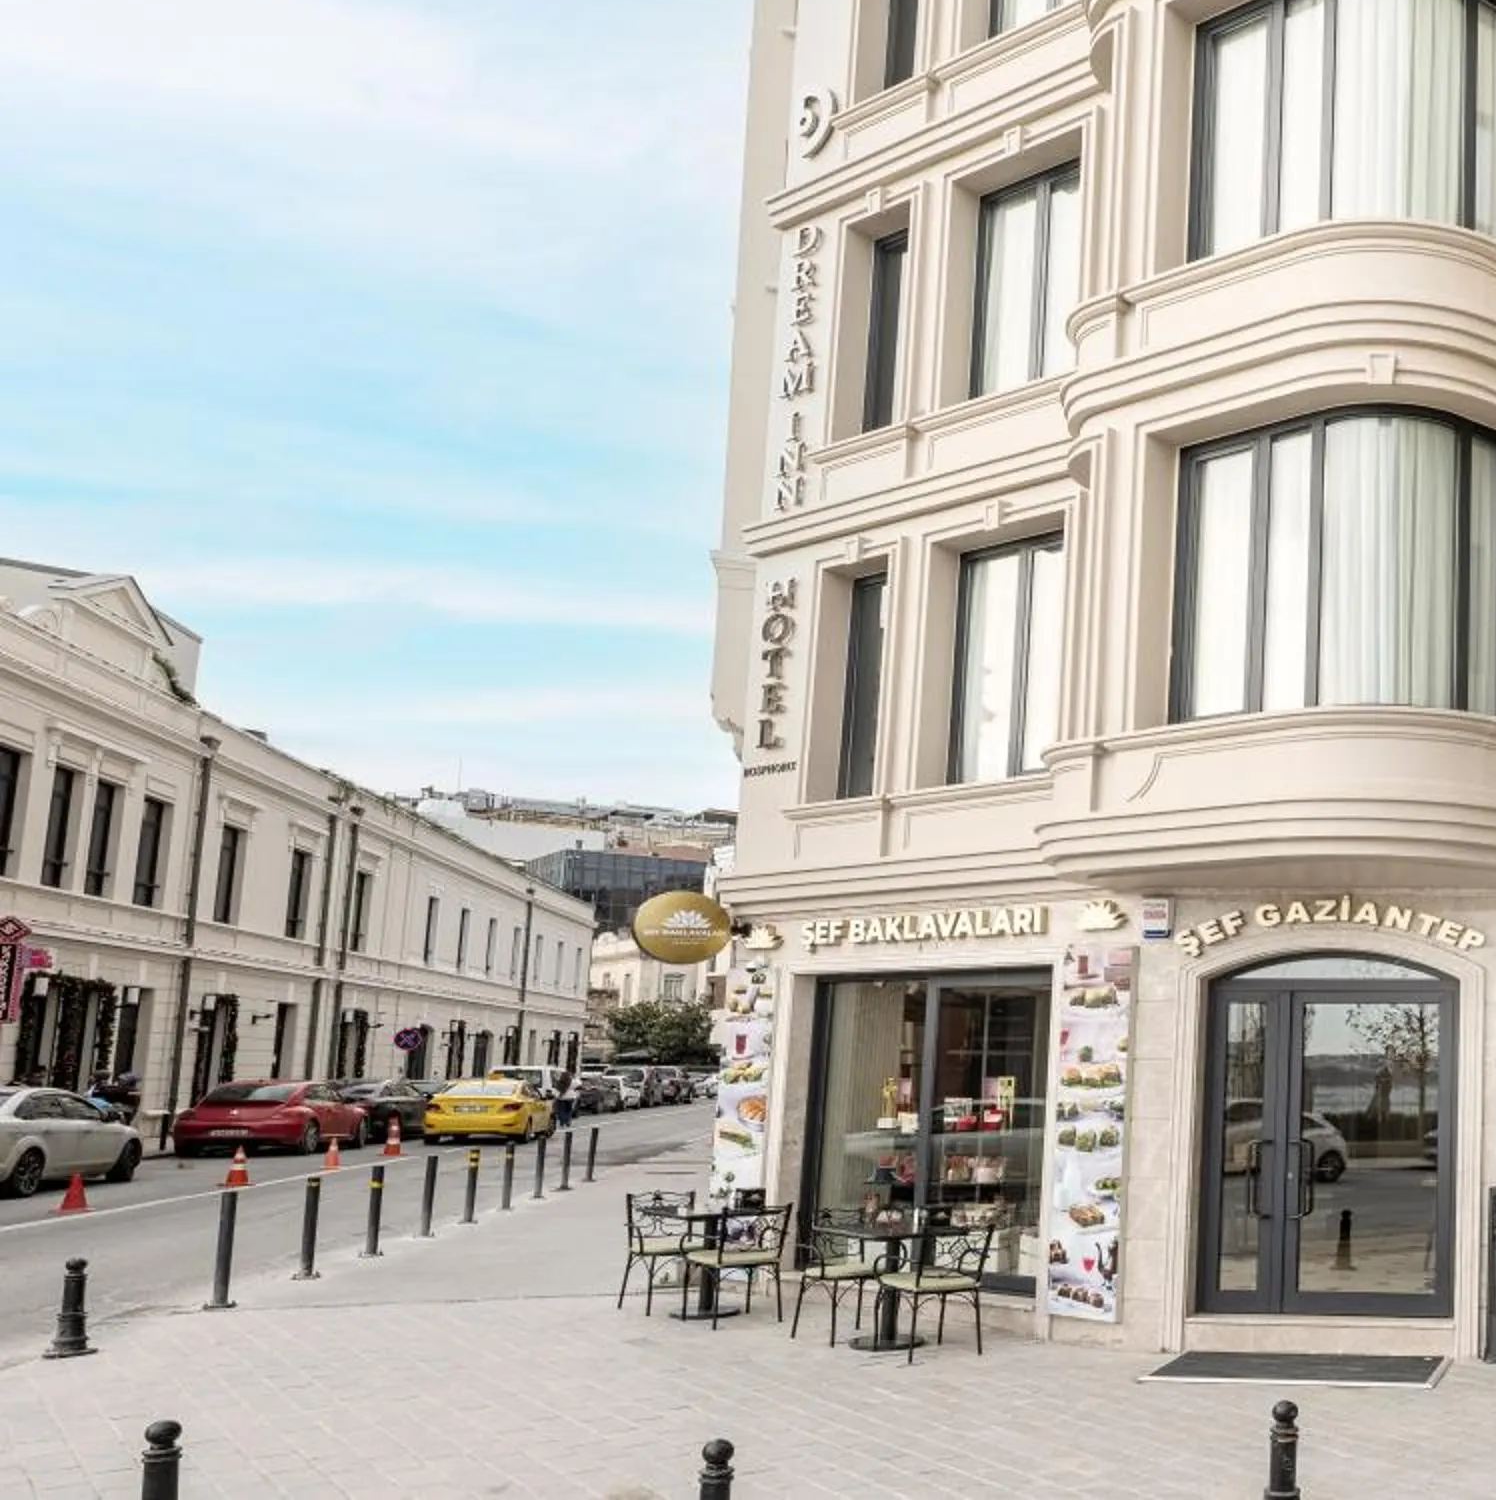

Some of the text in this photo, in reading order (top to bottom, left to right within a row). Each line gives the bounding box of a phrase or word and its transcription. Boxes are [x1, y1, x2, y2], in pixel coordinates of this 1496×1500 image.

[779, 225, 822, 401] DREAM
[756, 578, 797, 749] HOTEL
[801, 905, 1048, 953] ŞEF BAKLAVALARI
[1174, 895, 1486, 957] ŞEF GAZİANTEP
